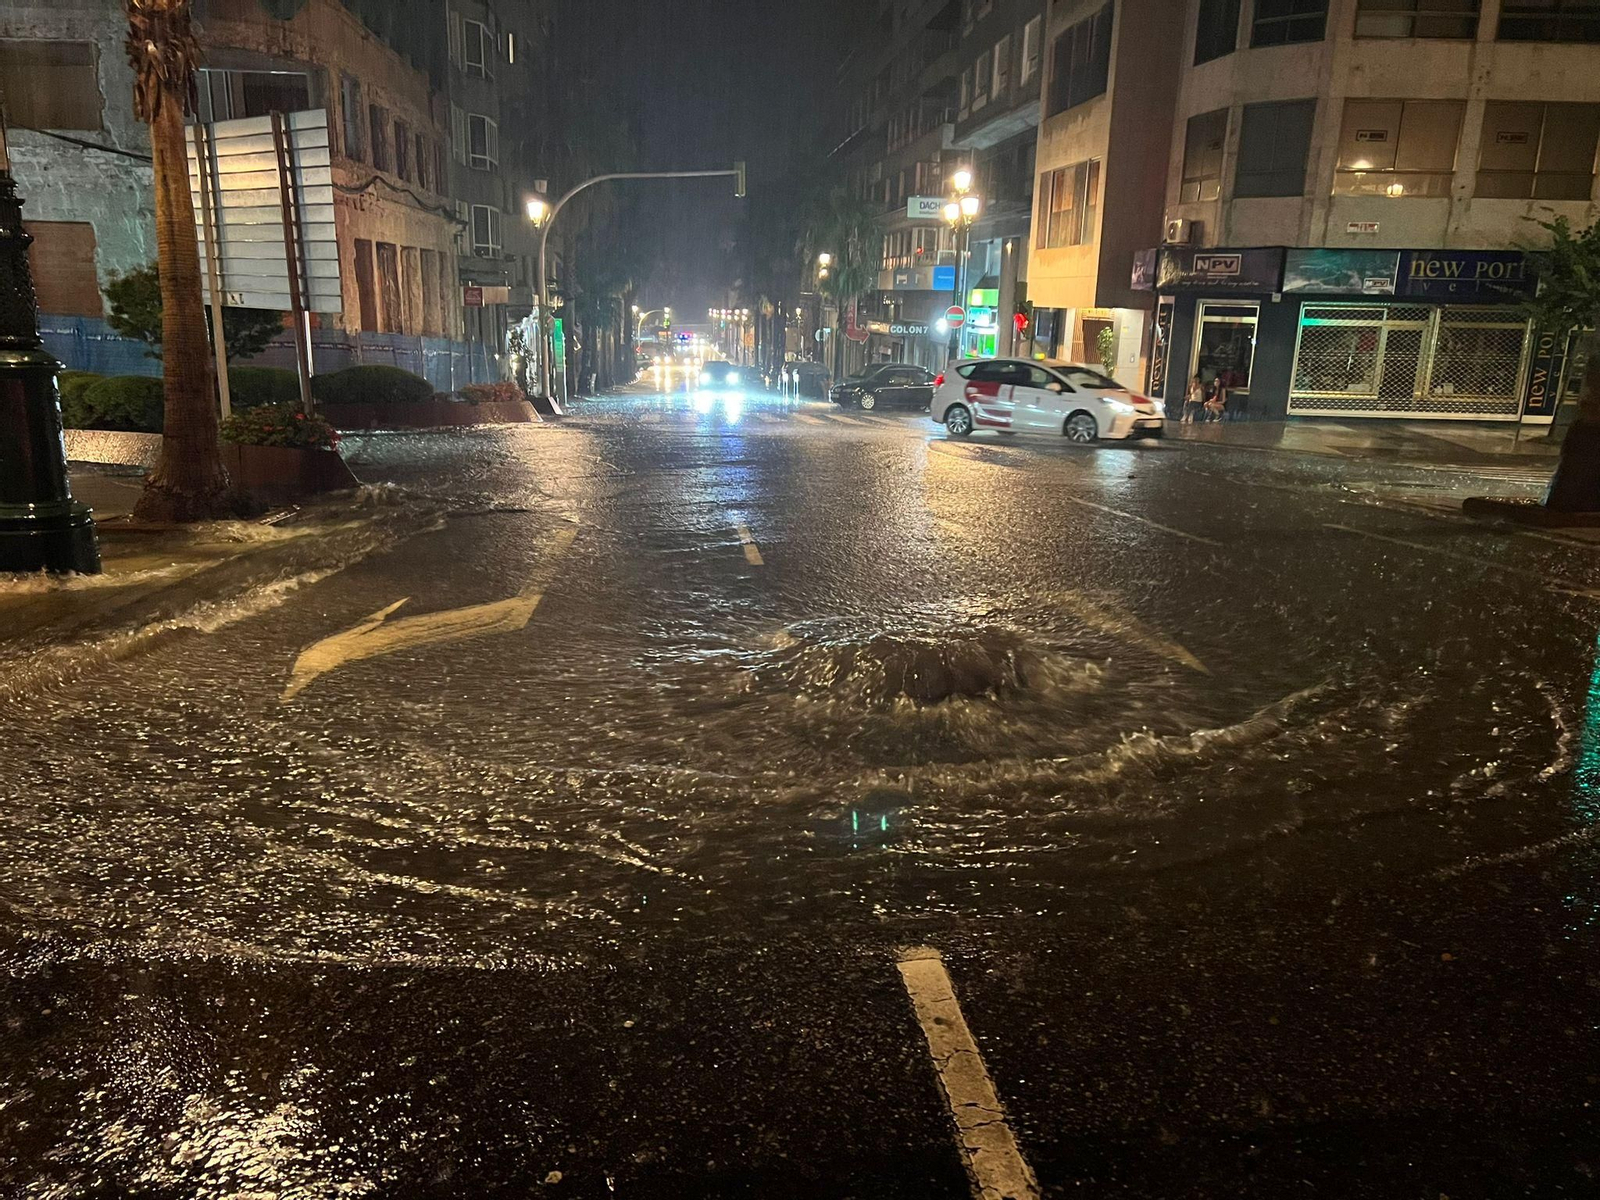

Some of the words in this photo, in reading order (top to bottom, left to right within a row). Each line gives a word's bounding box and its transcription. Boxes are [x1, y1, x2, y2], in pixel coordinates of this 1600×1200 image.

[1195, 259, 1237, 271] NPV
[1409, 259, 1465, 278] new
[1528, 366, 1548, 407] new
